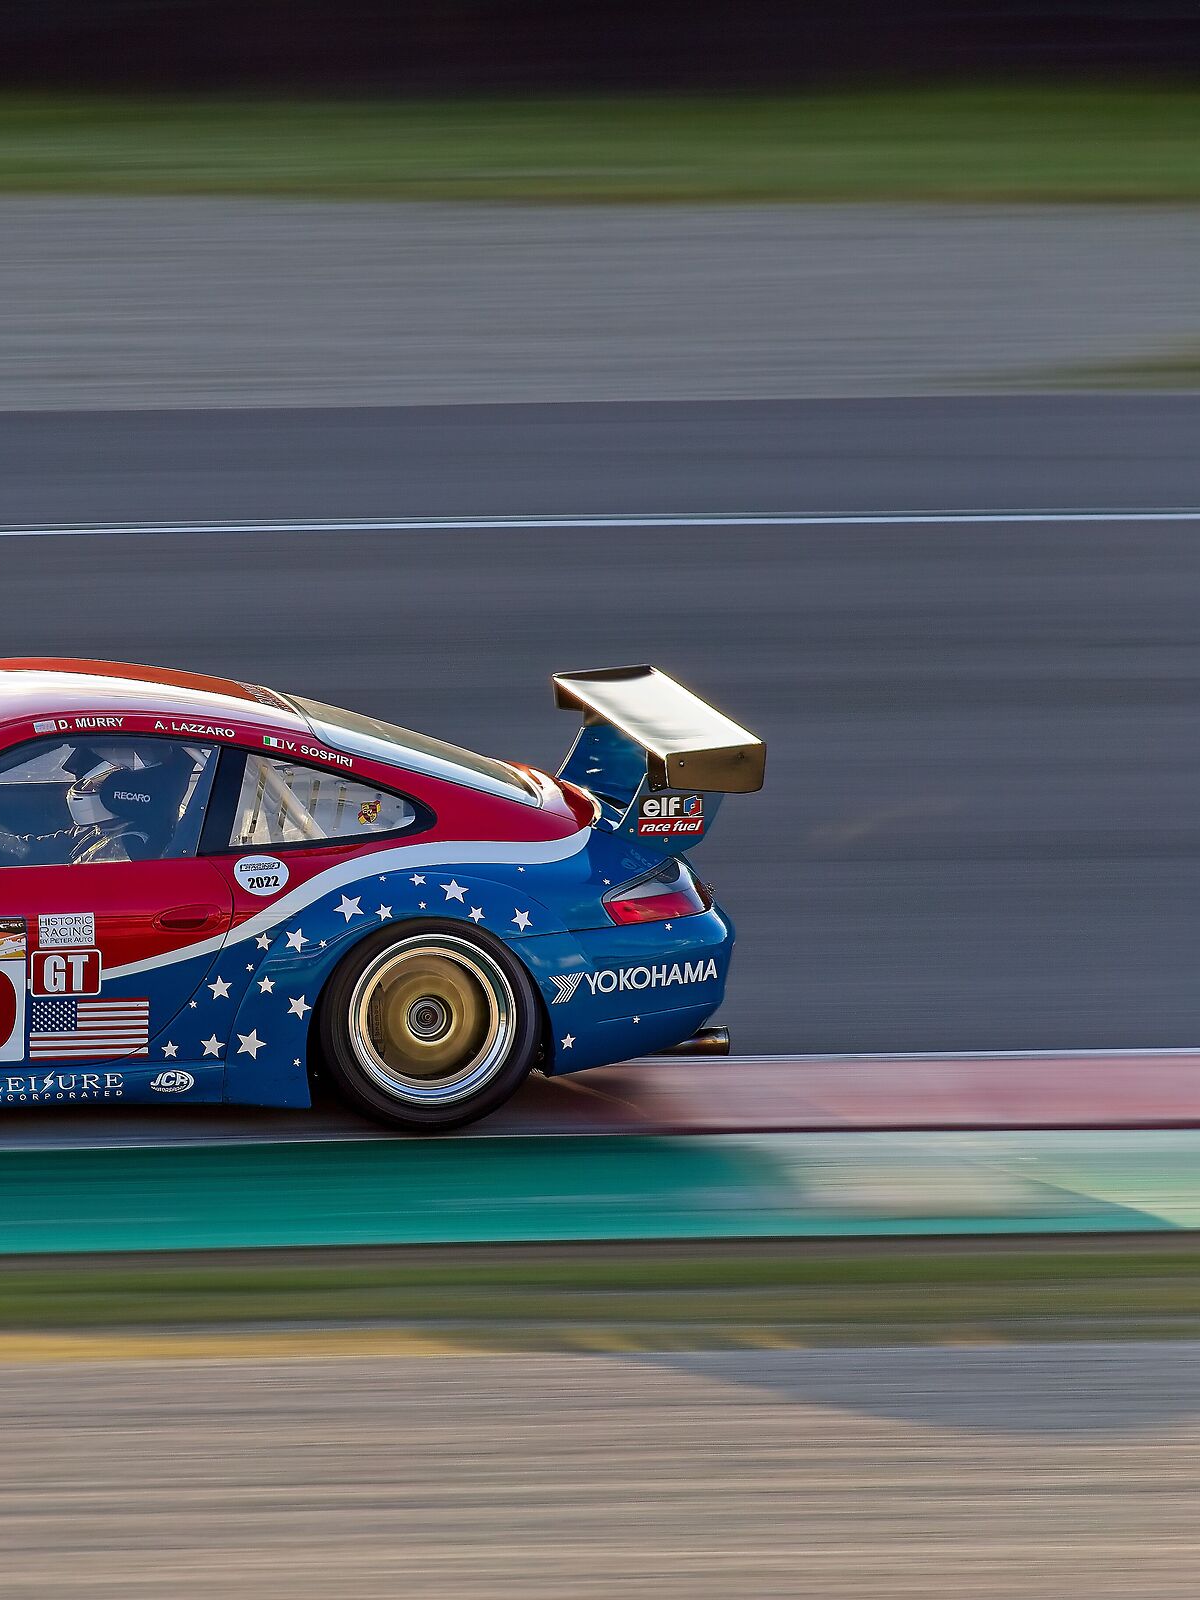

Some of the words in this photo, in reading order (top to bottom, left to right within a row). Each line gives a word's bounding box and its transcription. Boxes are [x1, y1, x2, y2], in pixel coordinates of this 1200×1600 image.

[58, 719, 73, 730] D.
[75, 717, 125, 729] MURRY
[154, 720, 168, 730] A.
[172, 721, 236, 738] LAZZARO
[285, 740, 297, 752] V.
[300, 744, 353, 768] SOSPIRI
[113, 791, 151, 803] RECARO
[642, 796, 681, 817] elf
[640, 823, 671, 832] race
[672, 819, 702, 832] fuel
[247, 875, 280, 889] 2022
[39, 915, 93, 926] HISTORIC
[39, 924, 93, 938] RACING
[43, 954, 89, 993] GT
[584, 958, 719, 995] YOKOHAMA
